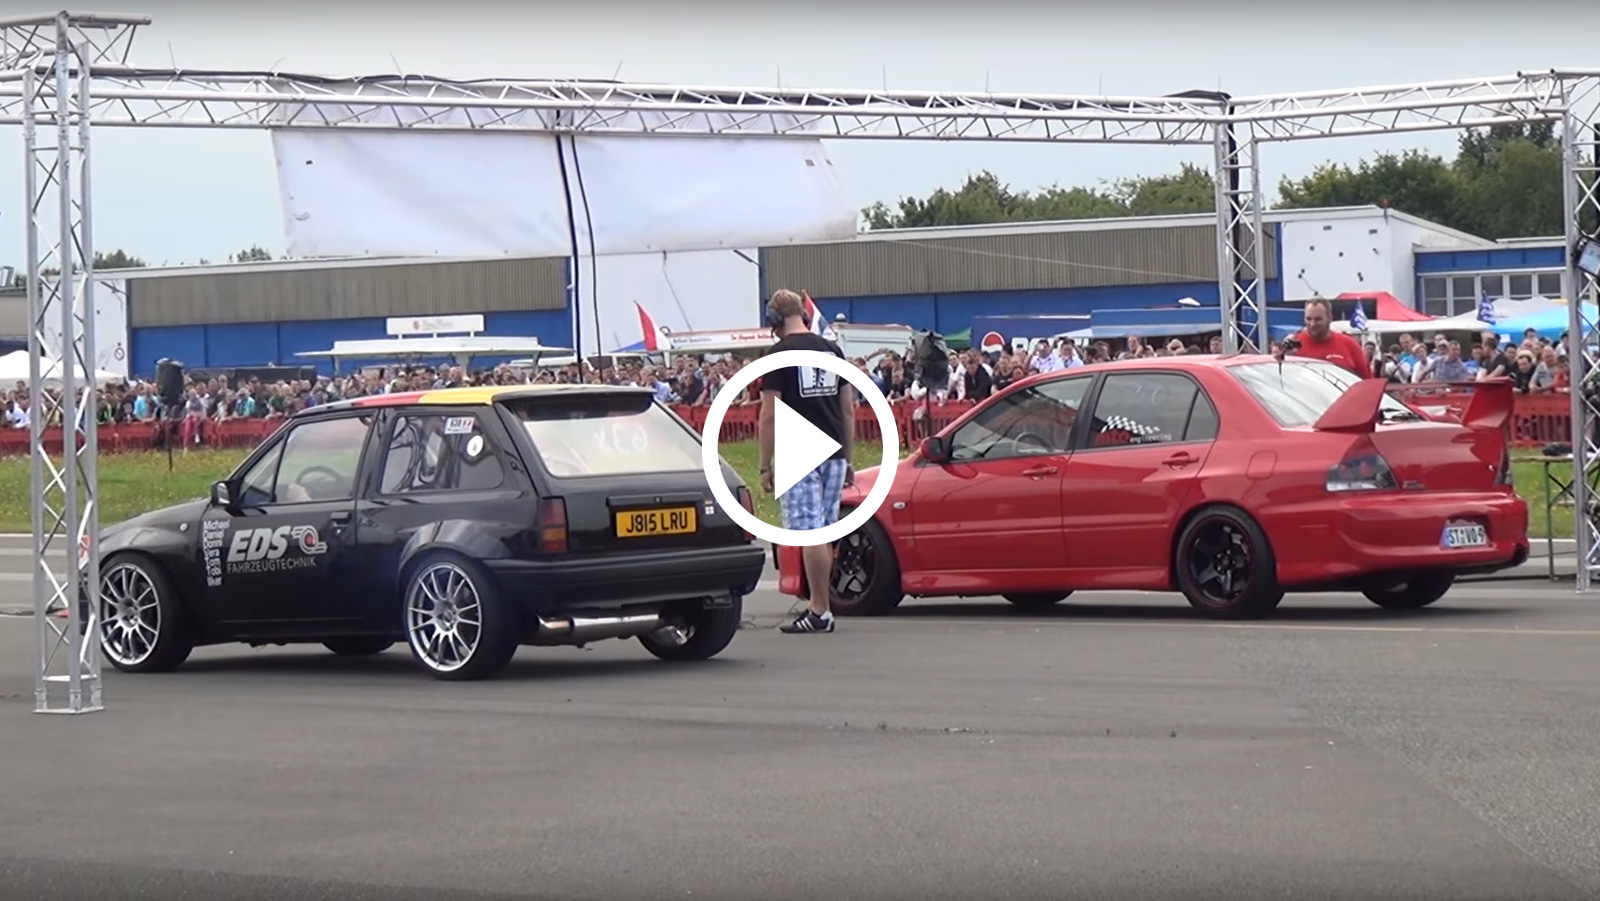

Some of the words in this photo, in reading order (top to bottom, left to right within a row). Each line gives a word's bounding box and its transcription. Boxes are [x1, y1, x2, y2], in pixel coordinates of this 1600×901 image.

[203, 519, 230, 531] Michael
[626, 514, 657, 533] J815
[661, 511, 688, 530] LRU
[203, 529, 225, 541] Daniel
[227, 525, 291, 562] EDS
[227, 557, 316, 573] FAHRZEUGTECHNIK
